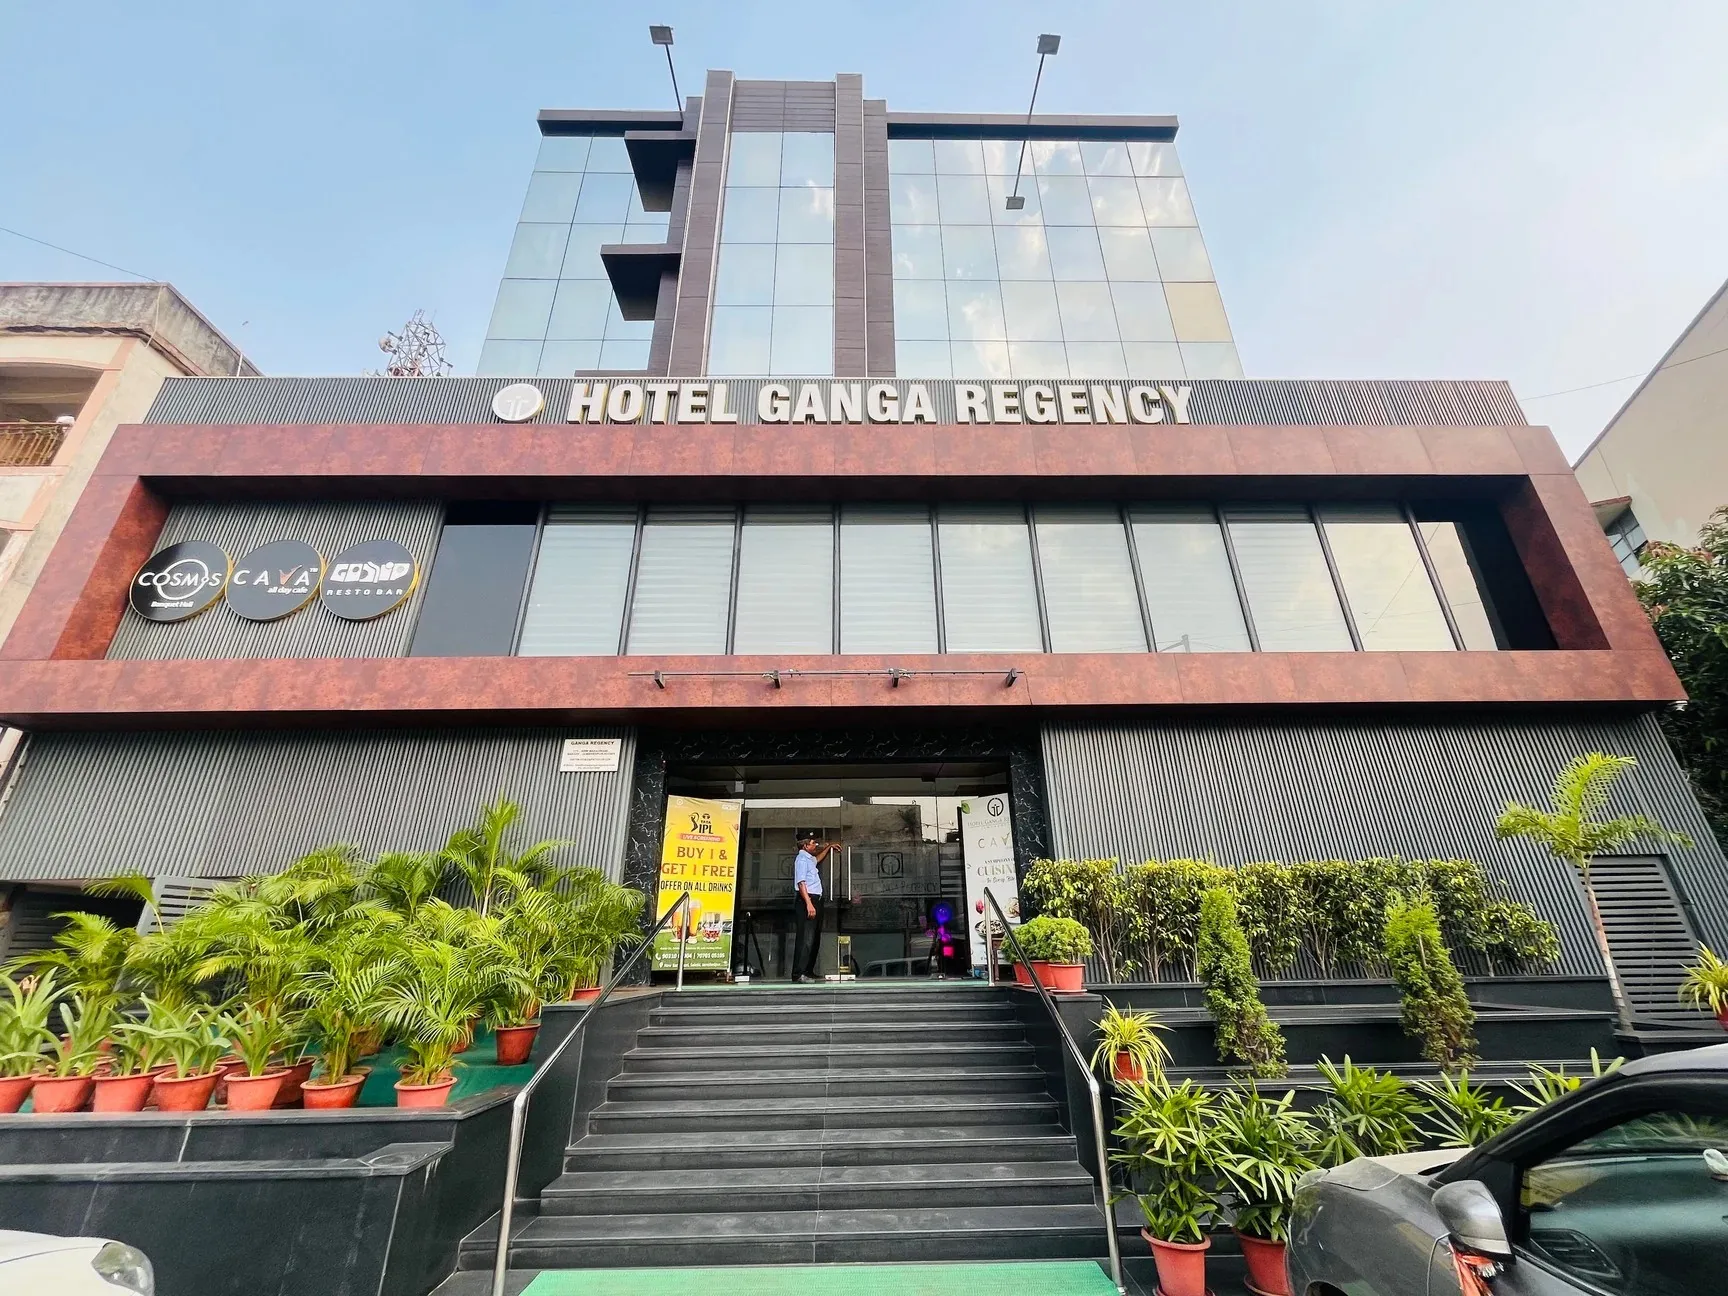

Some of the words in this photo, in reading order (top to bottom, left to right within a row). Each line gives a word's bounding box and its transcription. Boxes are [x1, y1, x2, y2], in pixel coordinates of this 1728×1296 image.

[567, 382, 738, 424] HOTEL
[757, 383, 937, 424] GANGA
[955, 384, 1192, 425] REGENCY
[267, 586, 278, 594] all
[278, 586, 292, 595] day
[292, 586, 309, 594] cafe
[698, 824, 714, 835] IPL
[977, 831, 1011, 849] CAV
[677, 846, 704, 859] BUY
[718, 849, 728, 860] &
[661, 862, 687, 875] GET
[702, 865, 735, 878] FREE
[977, 864, 1016, 877] CUISIN
[660, 880, 682, 890] OFFER
[683, 881, 693, 891] ON
[694, 882, 706, 892] ALL
[708, 882, 733, 893] DRINKS
